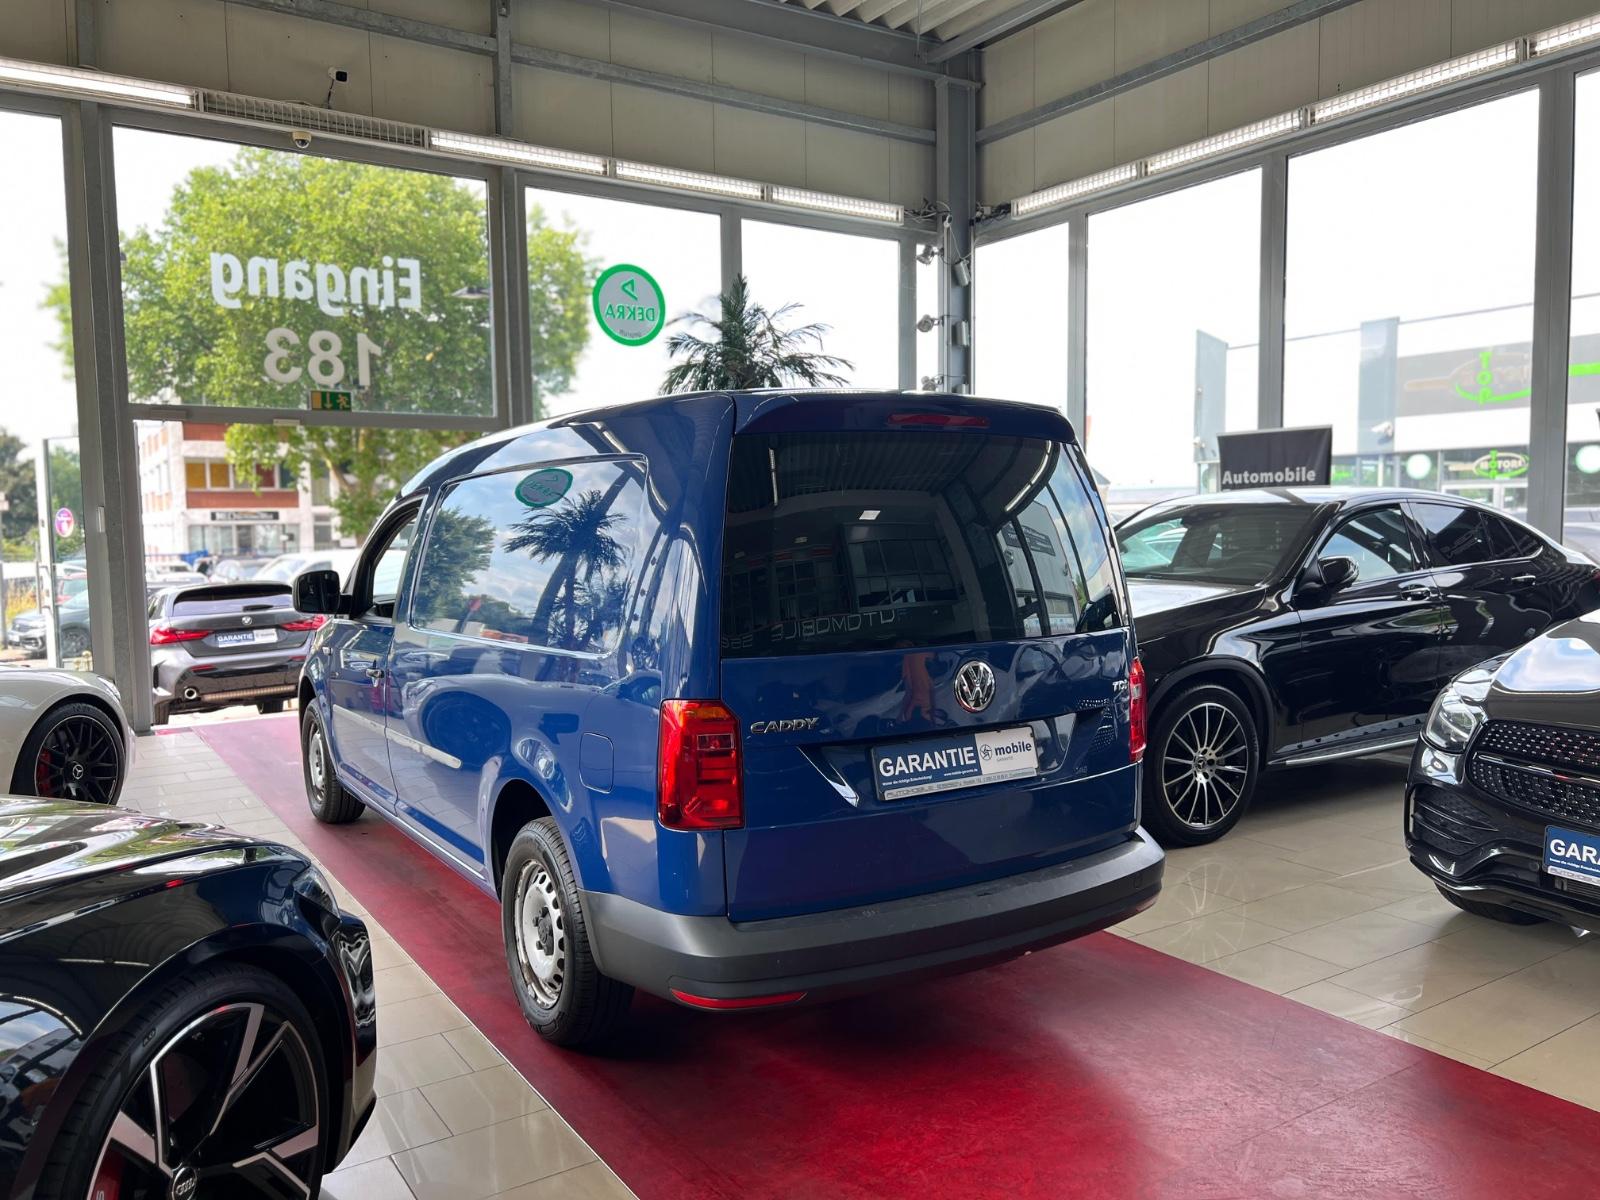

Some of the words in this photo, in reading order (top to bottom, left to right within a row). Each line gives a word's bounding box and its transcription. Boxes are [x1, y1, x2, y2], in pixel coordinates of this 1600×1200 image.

[1222, 466, 1316, 485] Automobile
[217, 632, 254, 642] GARANTIE
[750, 717, 819, 734] CADDY
[994, 741, 1032, 756] mobile
[879, 746, 977, 777] GARANTIE
[1549, 839, 1600, 865] GAR
